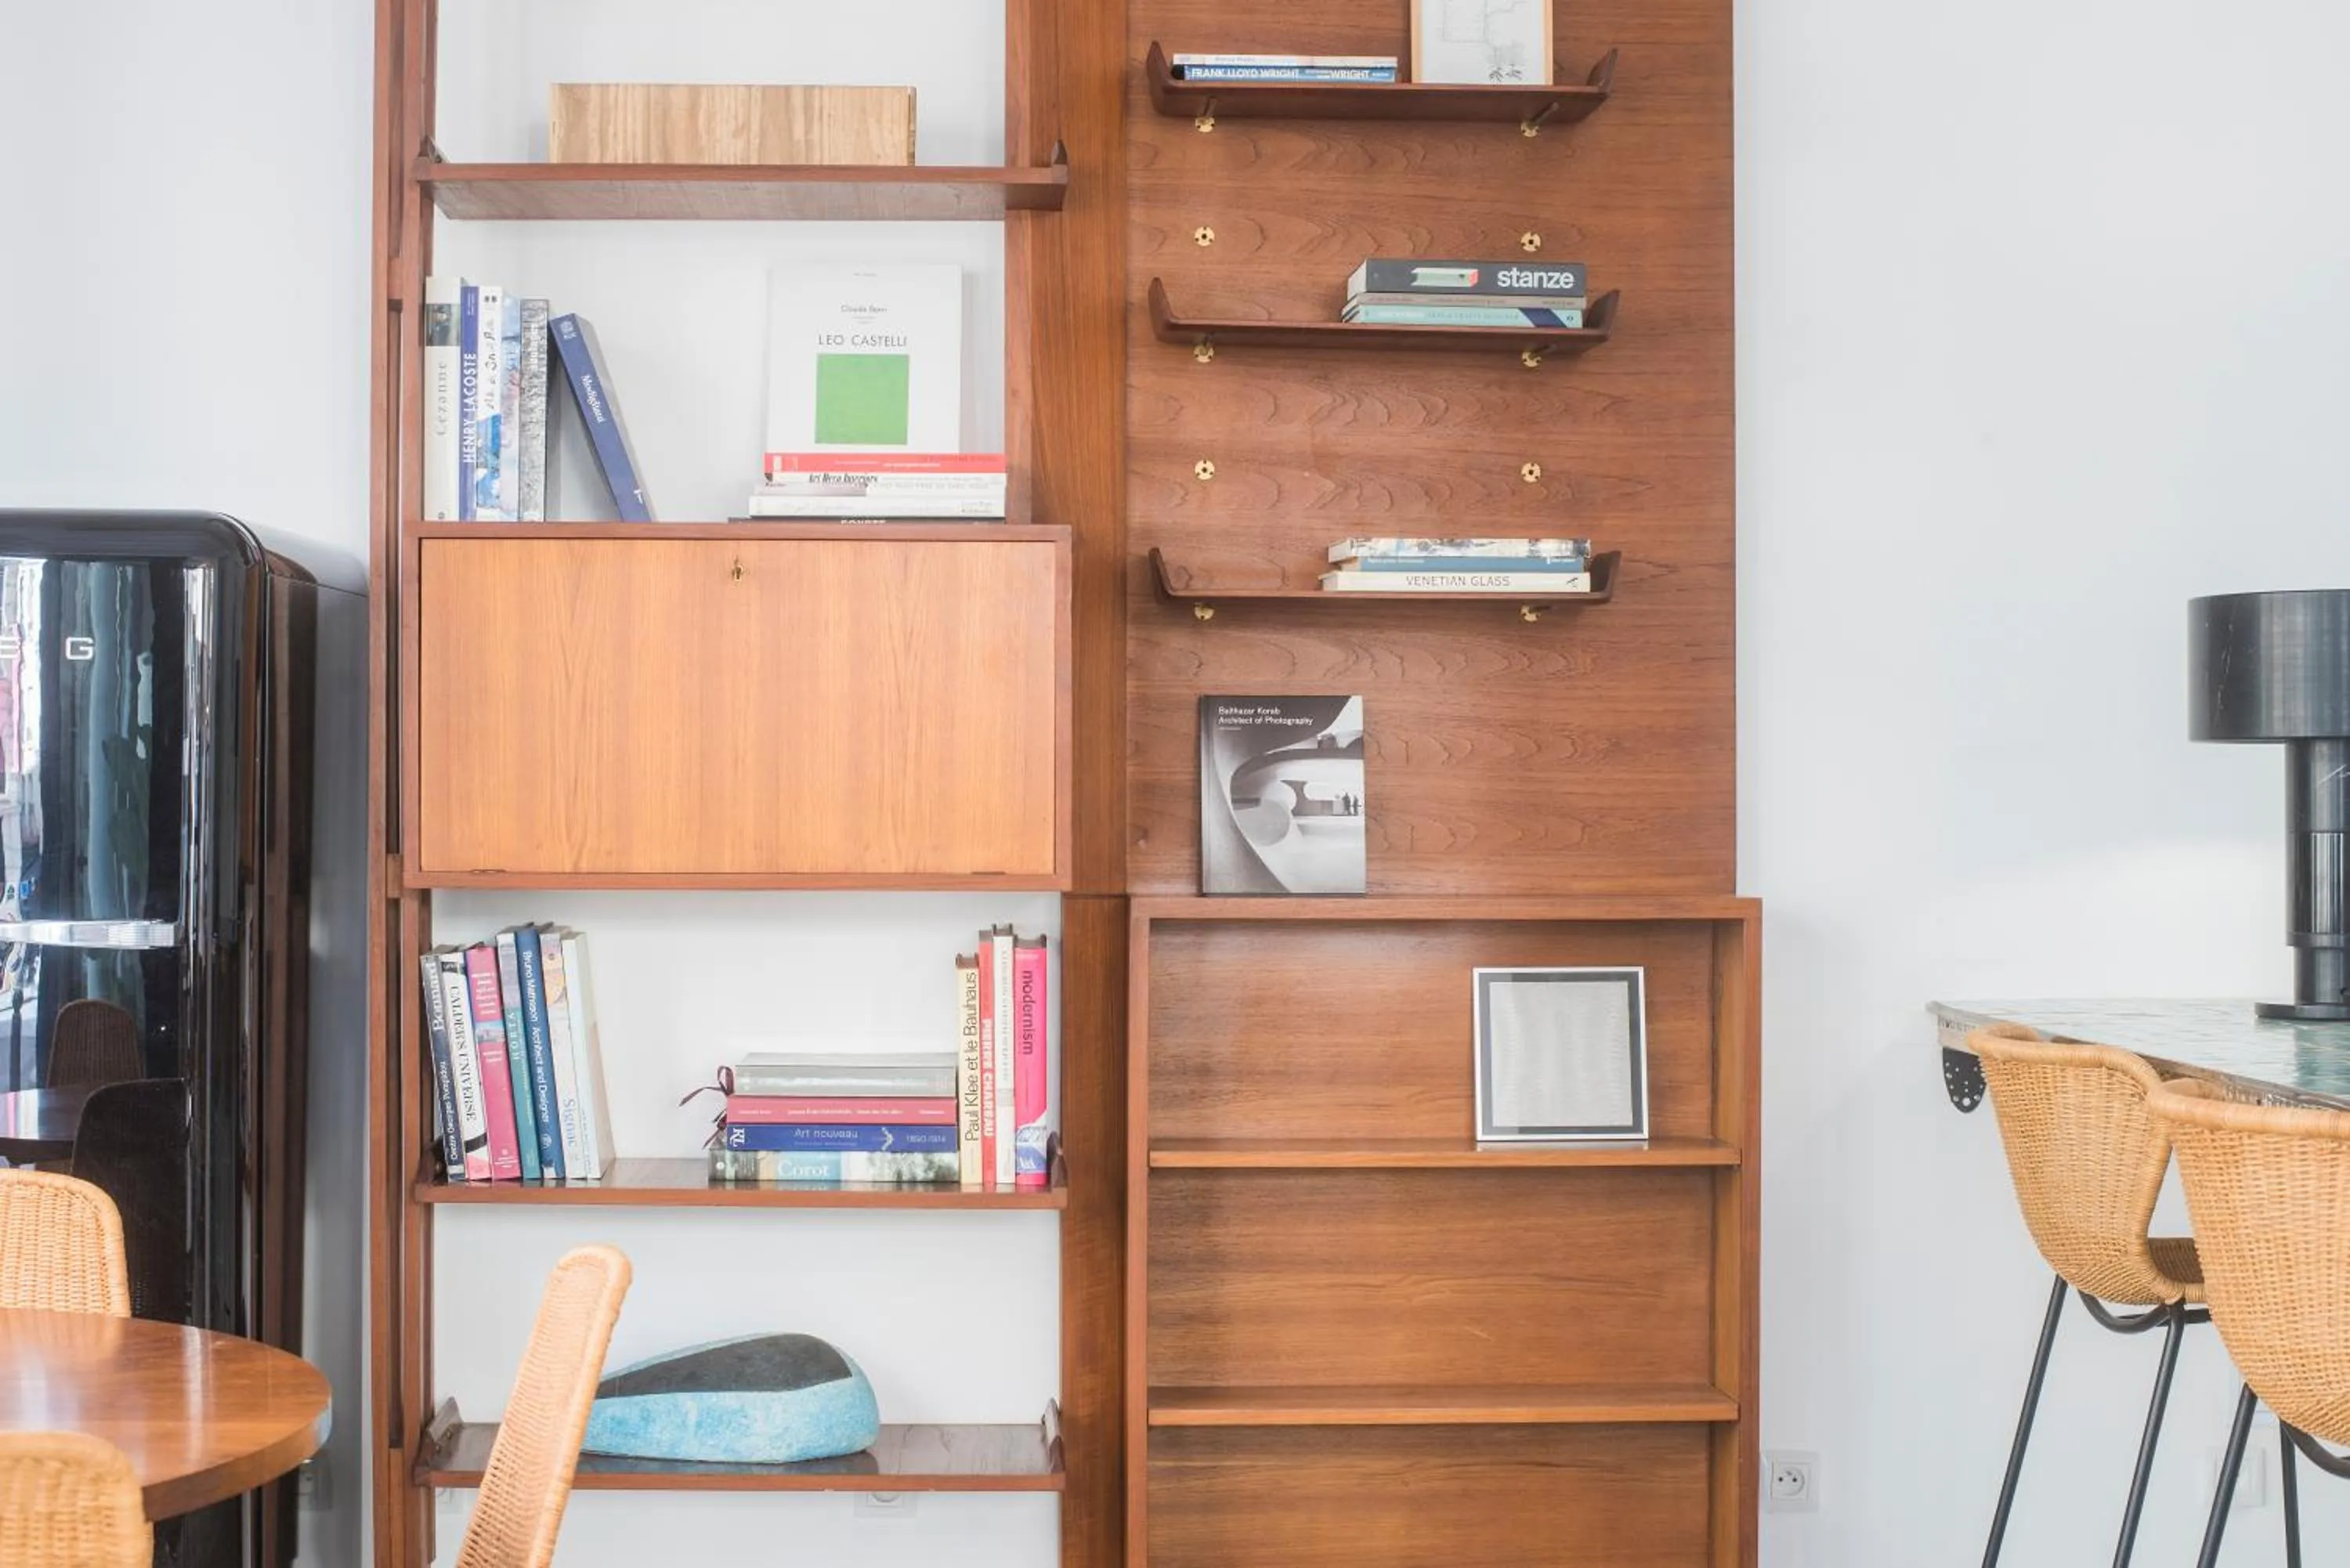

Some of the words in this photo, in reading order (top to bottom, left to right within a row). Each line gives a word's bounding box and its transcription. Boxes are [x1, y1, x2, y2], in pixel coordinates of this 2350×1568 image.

[1191, 67, 1224, 79] FRANK
[1227, 68, 1260, 80] LLOYD
[1261, 69, 1300, 80] WRIGHT
[1330, 69, 1370, 80] WRIGHT
[1497, 266, 1574, 289] stanze
[819, 334, 844, 346] LEO
[851, 334, 908, 347] CASTELLI
[464, 352, 478, 412] LACOSTE
[463, 414, 477, 464] HENRY
[1406, 576, 1467, 587] VENETIAN
[1471, 576, 1510, 587] GLASS
[1218, 706, 1255, 715] Balthazar
[1257, 706, 1281, 715] Korab
[1218, 716, 1253, 724] Architect
[1255, 716, 1264, 724] of
[1266, 716, 1314, 726] Photography
[522, 951, 533, 979] Bruno
[425, 962, 443, 1031] Bonnard
[963, 972, 978, 1036] Bauhaus
[1022, 970, 1036, 1056] modernism
[532, 1026, 544, 1067] Architect
[963, 1039, 978, 1054] le
[982, 1019, 992, 1069] PIERRE
[537, 1068, 546, 1083] and
[966, 1056, 978, 1077] et
[539, 1083, 550, 1122] Designer
[964, 1080, 978, 1111] Klee
[983, 1074, 993, 1136] CHAREAU
[794, 1129, 811, 1139] Art
[814, 1130, 858, 1140] nouveau
[964, 1112, 978, 1143] Paul
[778, 1158, 831, 1178] Corot
